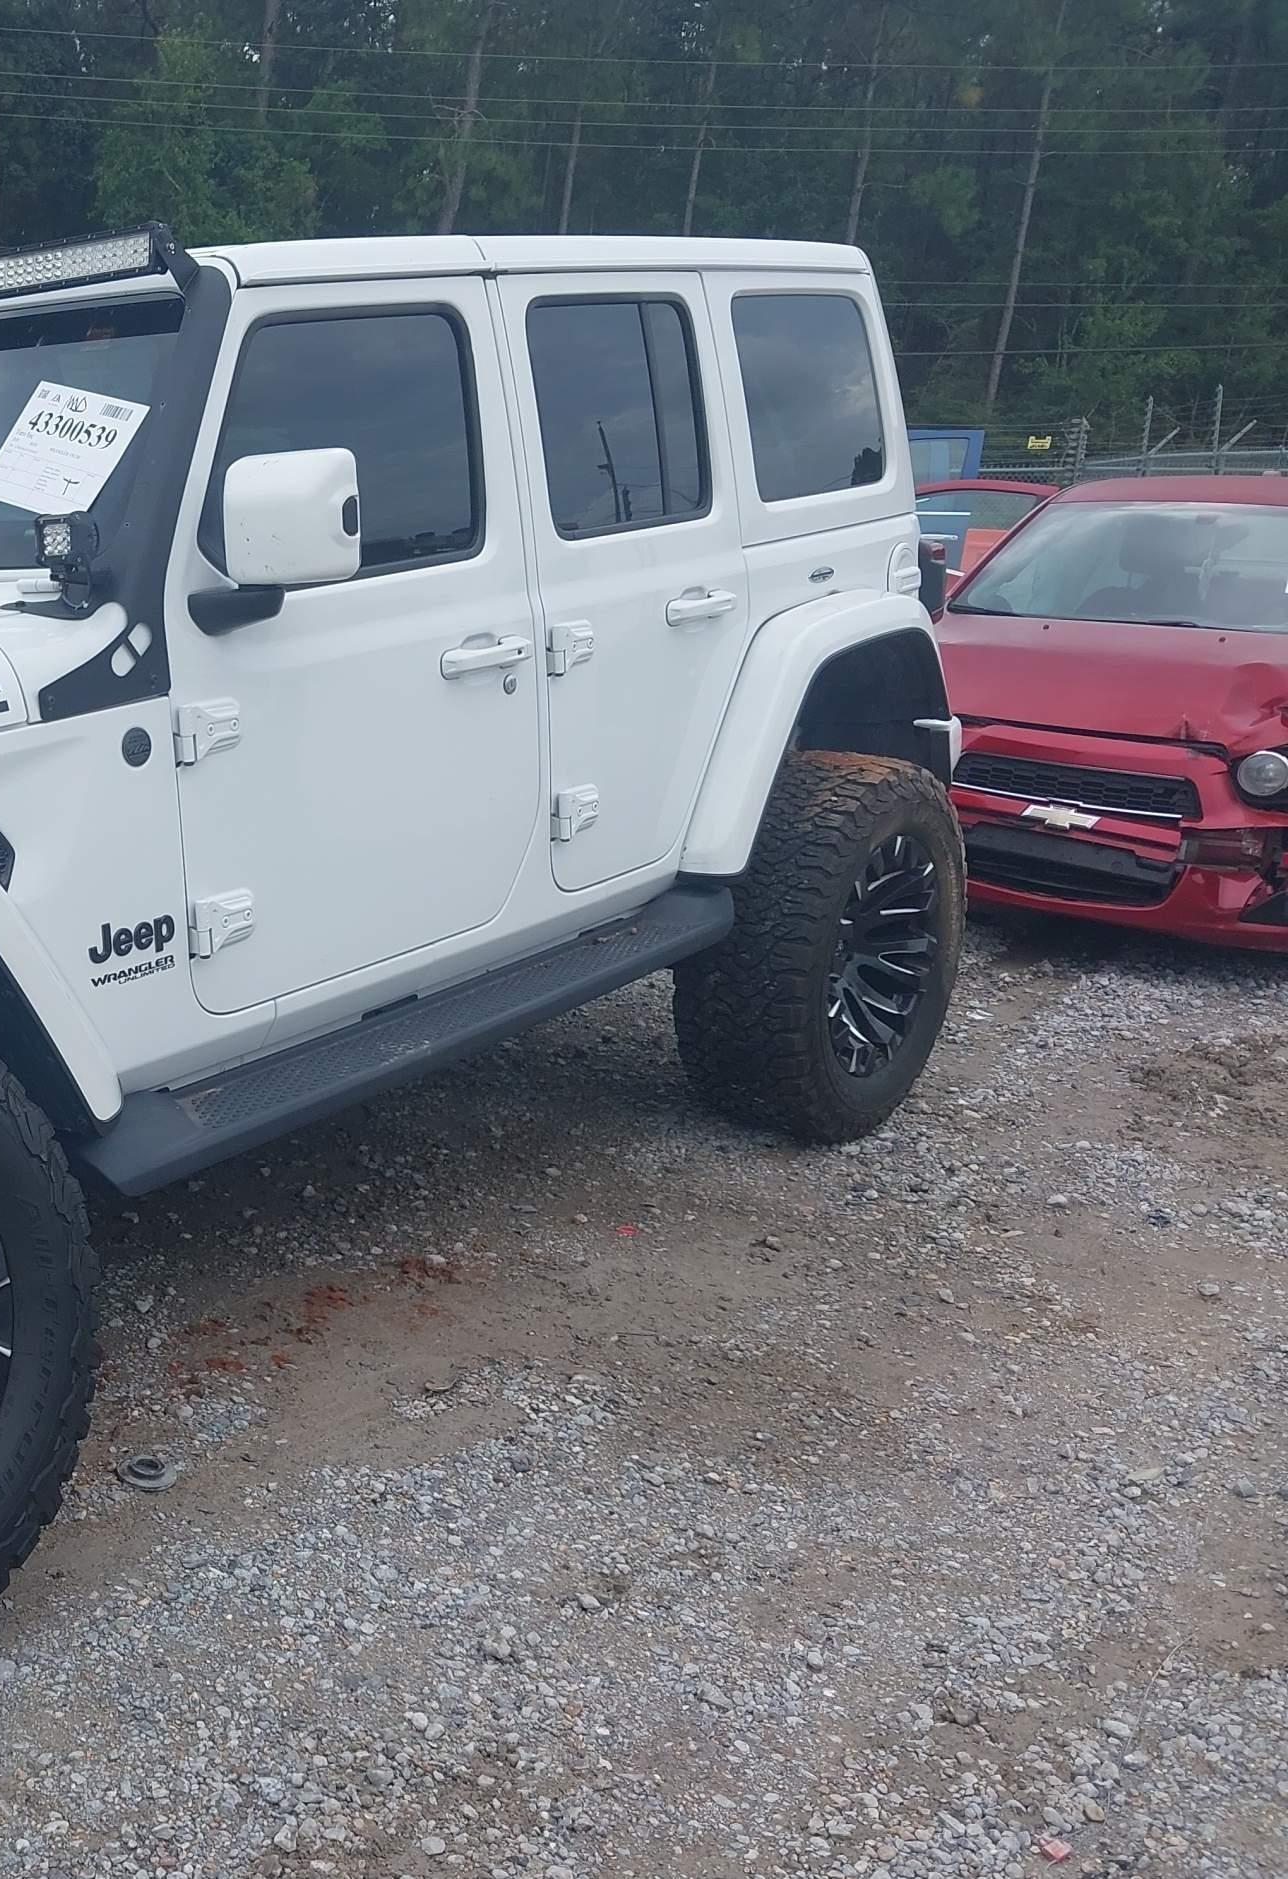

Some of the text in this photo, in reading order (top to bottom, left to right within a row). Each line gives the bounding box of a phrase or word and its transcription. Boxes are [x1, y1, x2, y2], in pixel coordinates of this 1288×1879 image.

[28, 410, 118, 450] 43300539
[88, 914, 175, 964] Jeep
[91, 954, 175, 987] WRANGLER
[118, 963, 176, 985] UNLIMITED
